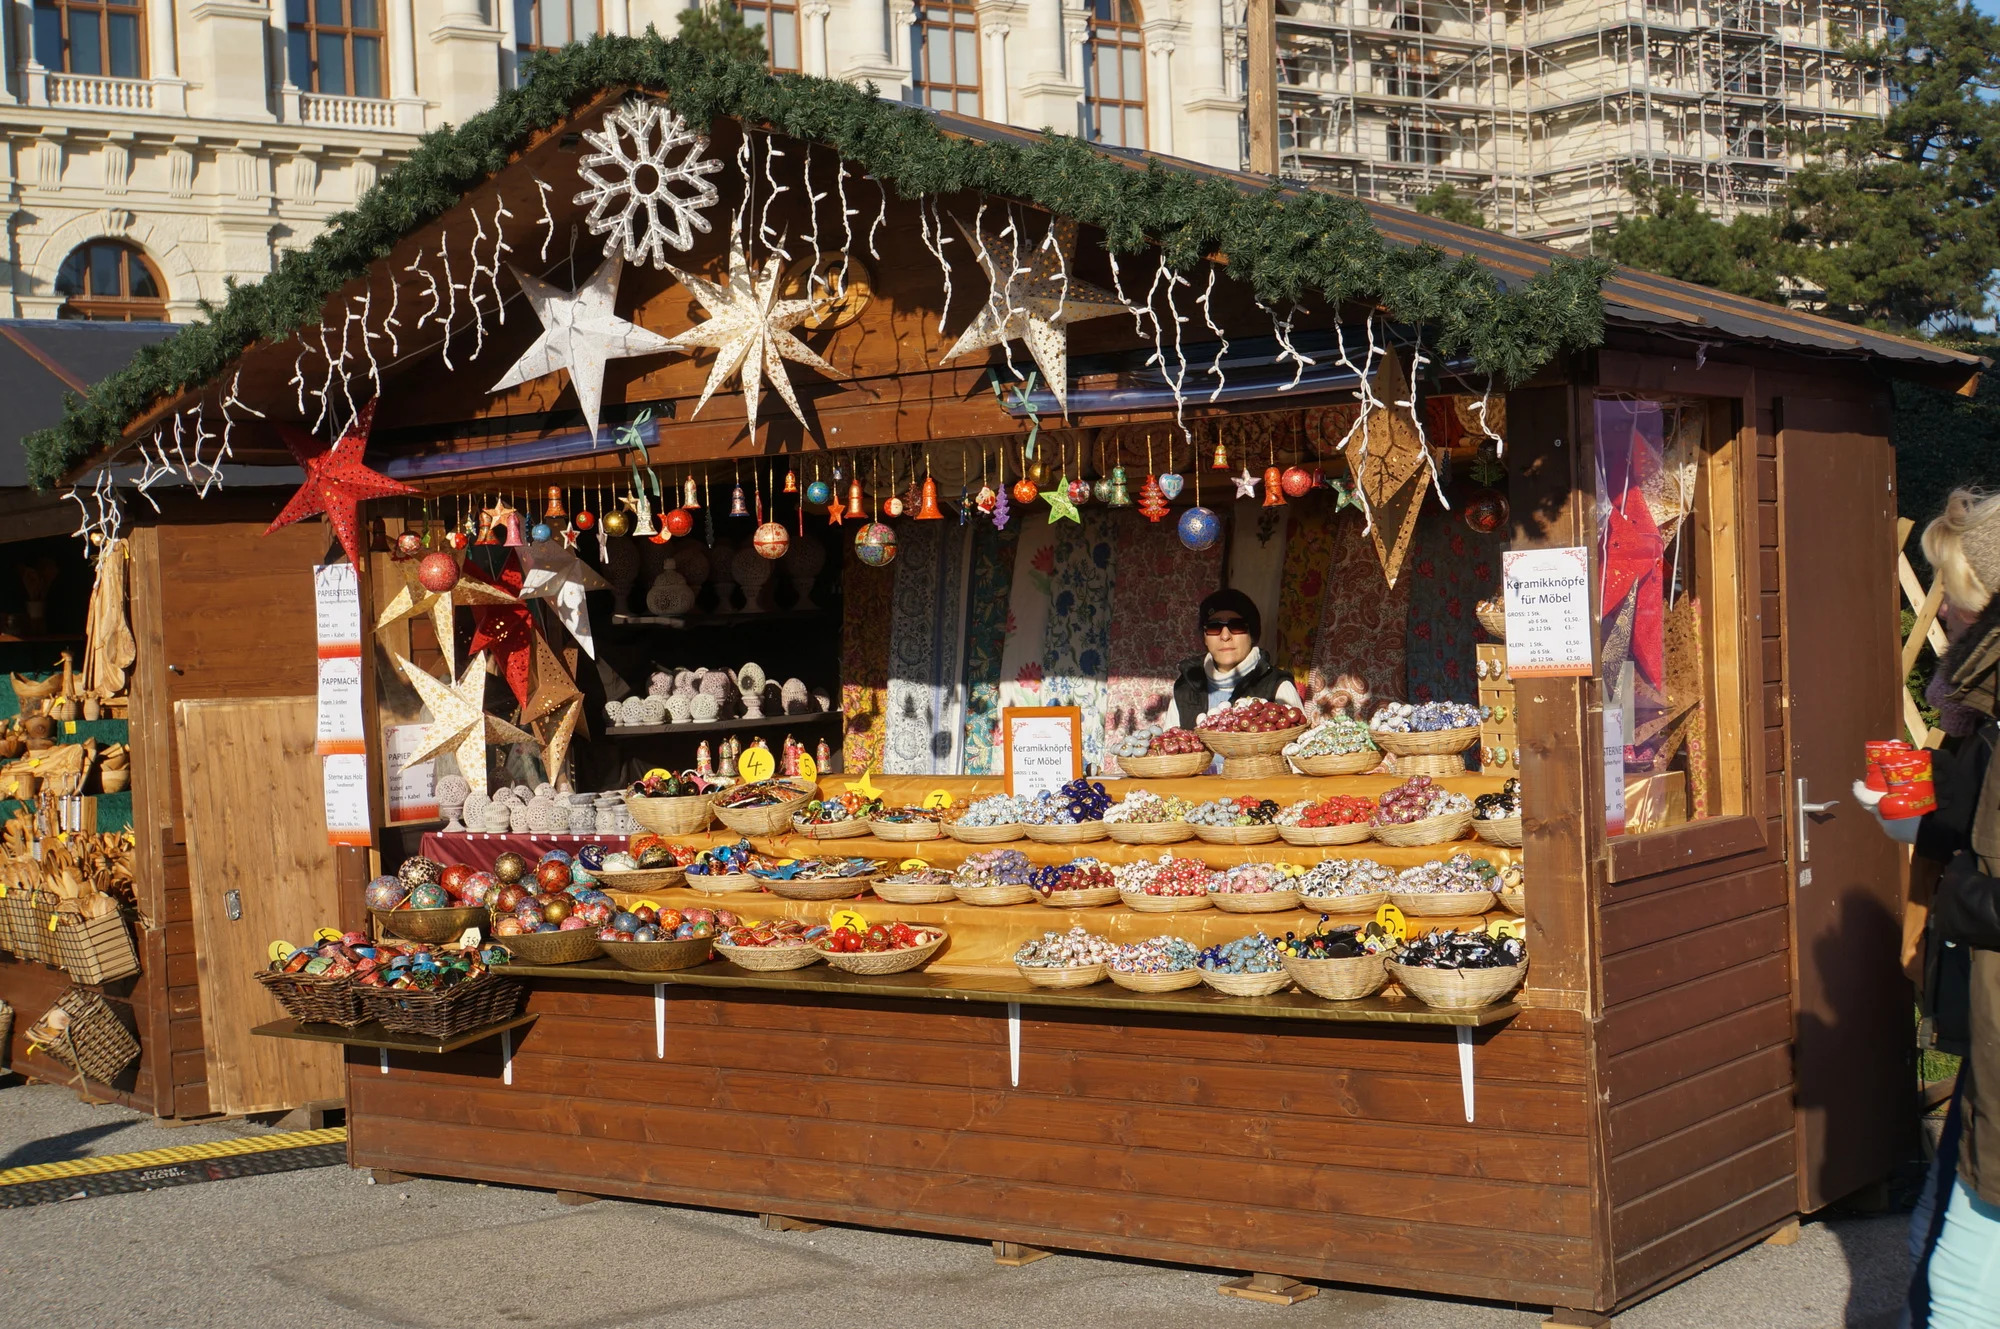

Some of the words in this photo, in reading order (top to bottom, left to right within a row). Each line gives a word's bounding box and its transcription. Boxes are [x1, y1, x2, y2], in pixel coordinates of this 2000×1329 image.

[1506, 575, 1585, 590] Keramikknöpfe
[317, 588, 357, 597] PAPIERSTERNE
[1521, 594, 1536, 604] für
[1539, 592, 1571, 604] Möbel
[322, 677, 359, 685] PAPPMACHE
[1013, 743, 1072, 754] Keramikknöpfe
[1024, 757, 1035, 765] für
[1037, 757, 1061, 765] Möbel
